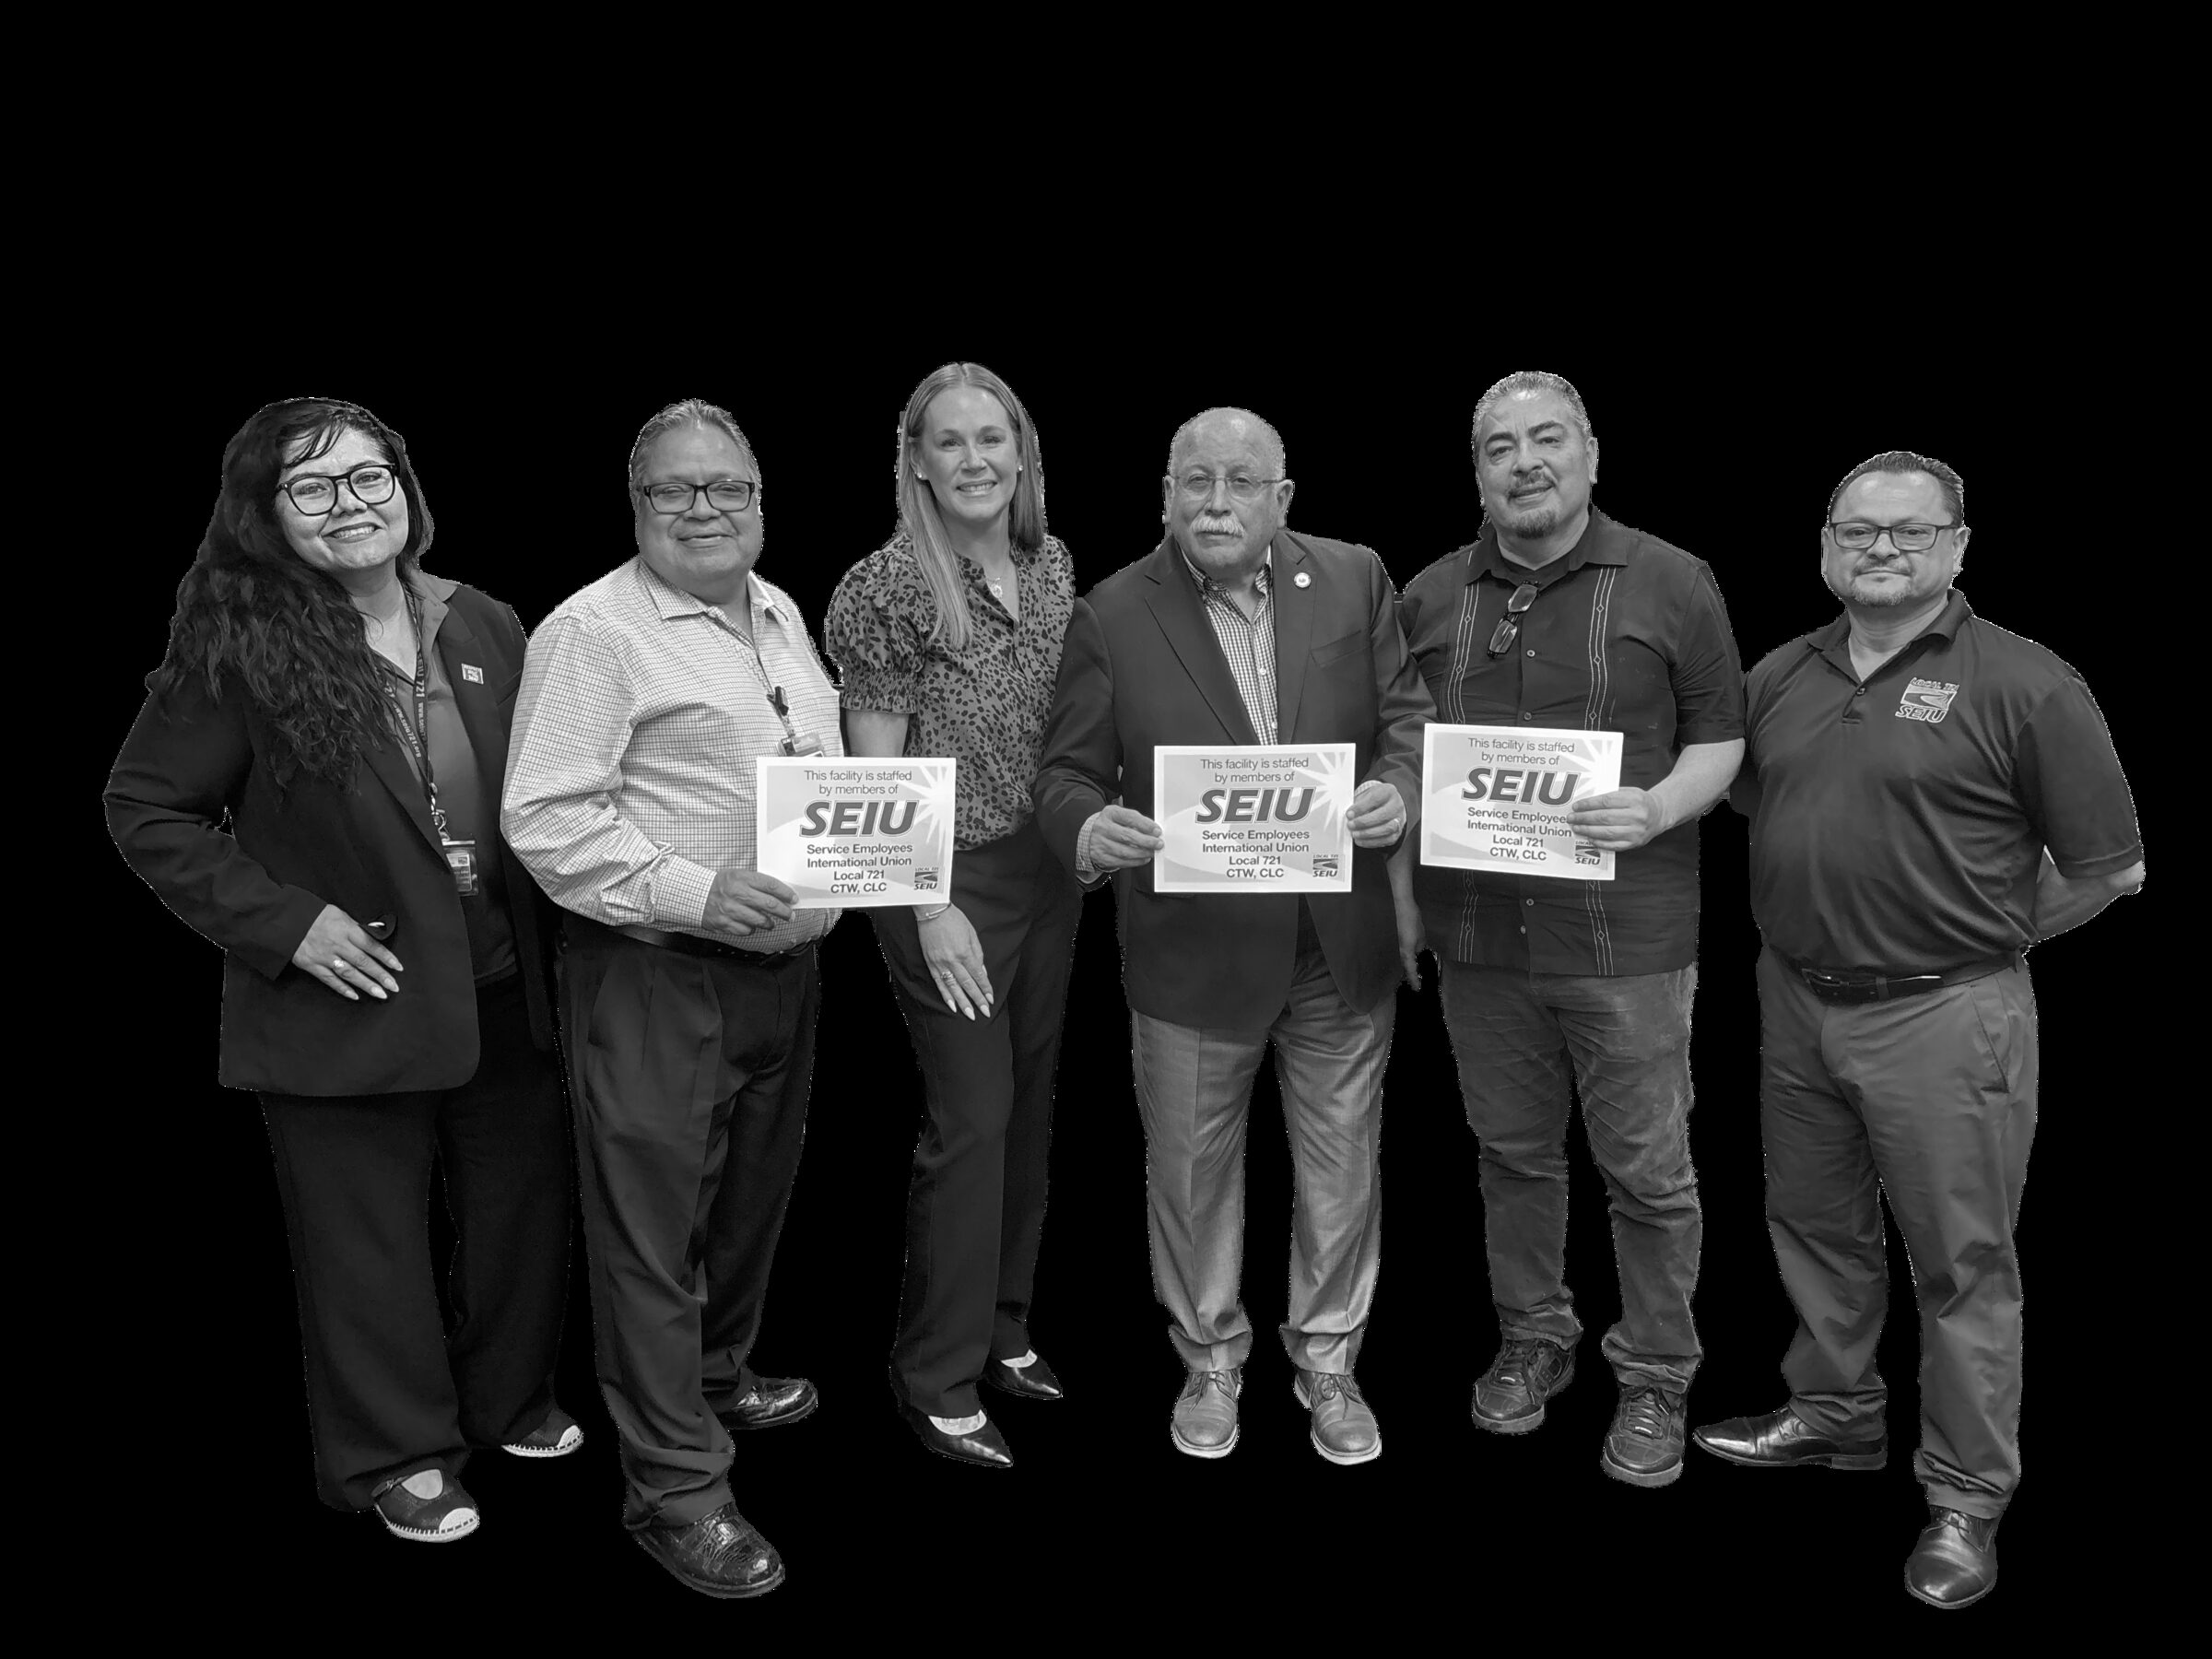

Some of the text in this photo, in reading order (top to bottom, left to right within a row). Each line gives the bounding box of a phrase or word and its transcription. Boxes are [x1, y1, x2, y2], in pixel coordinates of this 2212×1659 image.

[416, 680, 425, 697] 721
[1911, 677, 1942, 689] LOCAL
[1895, 704, 1948, 724] SEIU
[1468, 737, 1575, 753] This facility is staffed
[1200, 758, 1309, 771] This facility is staffed
[1481, 751, 1560, 765] by members of
[804, 771, 912, 782] This facility is staffed
[1215, 771, 1295, 784] by members of
[818, 784, 899, 796] by members of
[1461, 766, 1582, 807] SEIU
[1195, 787, 1316, 824] SEIU
[799, 800, 920, 838] SEIU
[1467, 806, 1568, 824] Service Employee
[1467, 819, 1572, 837] International Union
[1202, 830, 1310, 841] Service Employees
[1493, 835, 1544, 847] Local 721
[806, 843, 913, 854] Service Employees
[1202, 842, 1310, 853] International Union
[1489, 847, 1547, 861] CTW, CLC
[806, 856, 912, 868] International Union
[1229, 855, 1281, 865] Local 721
[833, 870, 885, 880] Local 721
[1226, 868, 1284, 879] CTW, CLC
[830, 882, 887, 895] CTW, CLC
